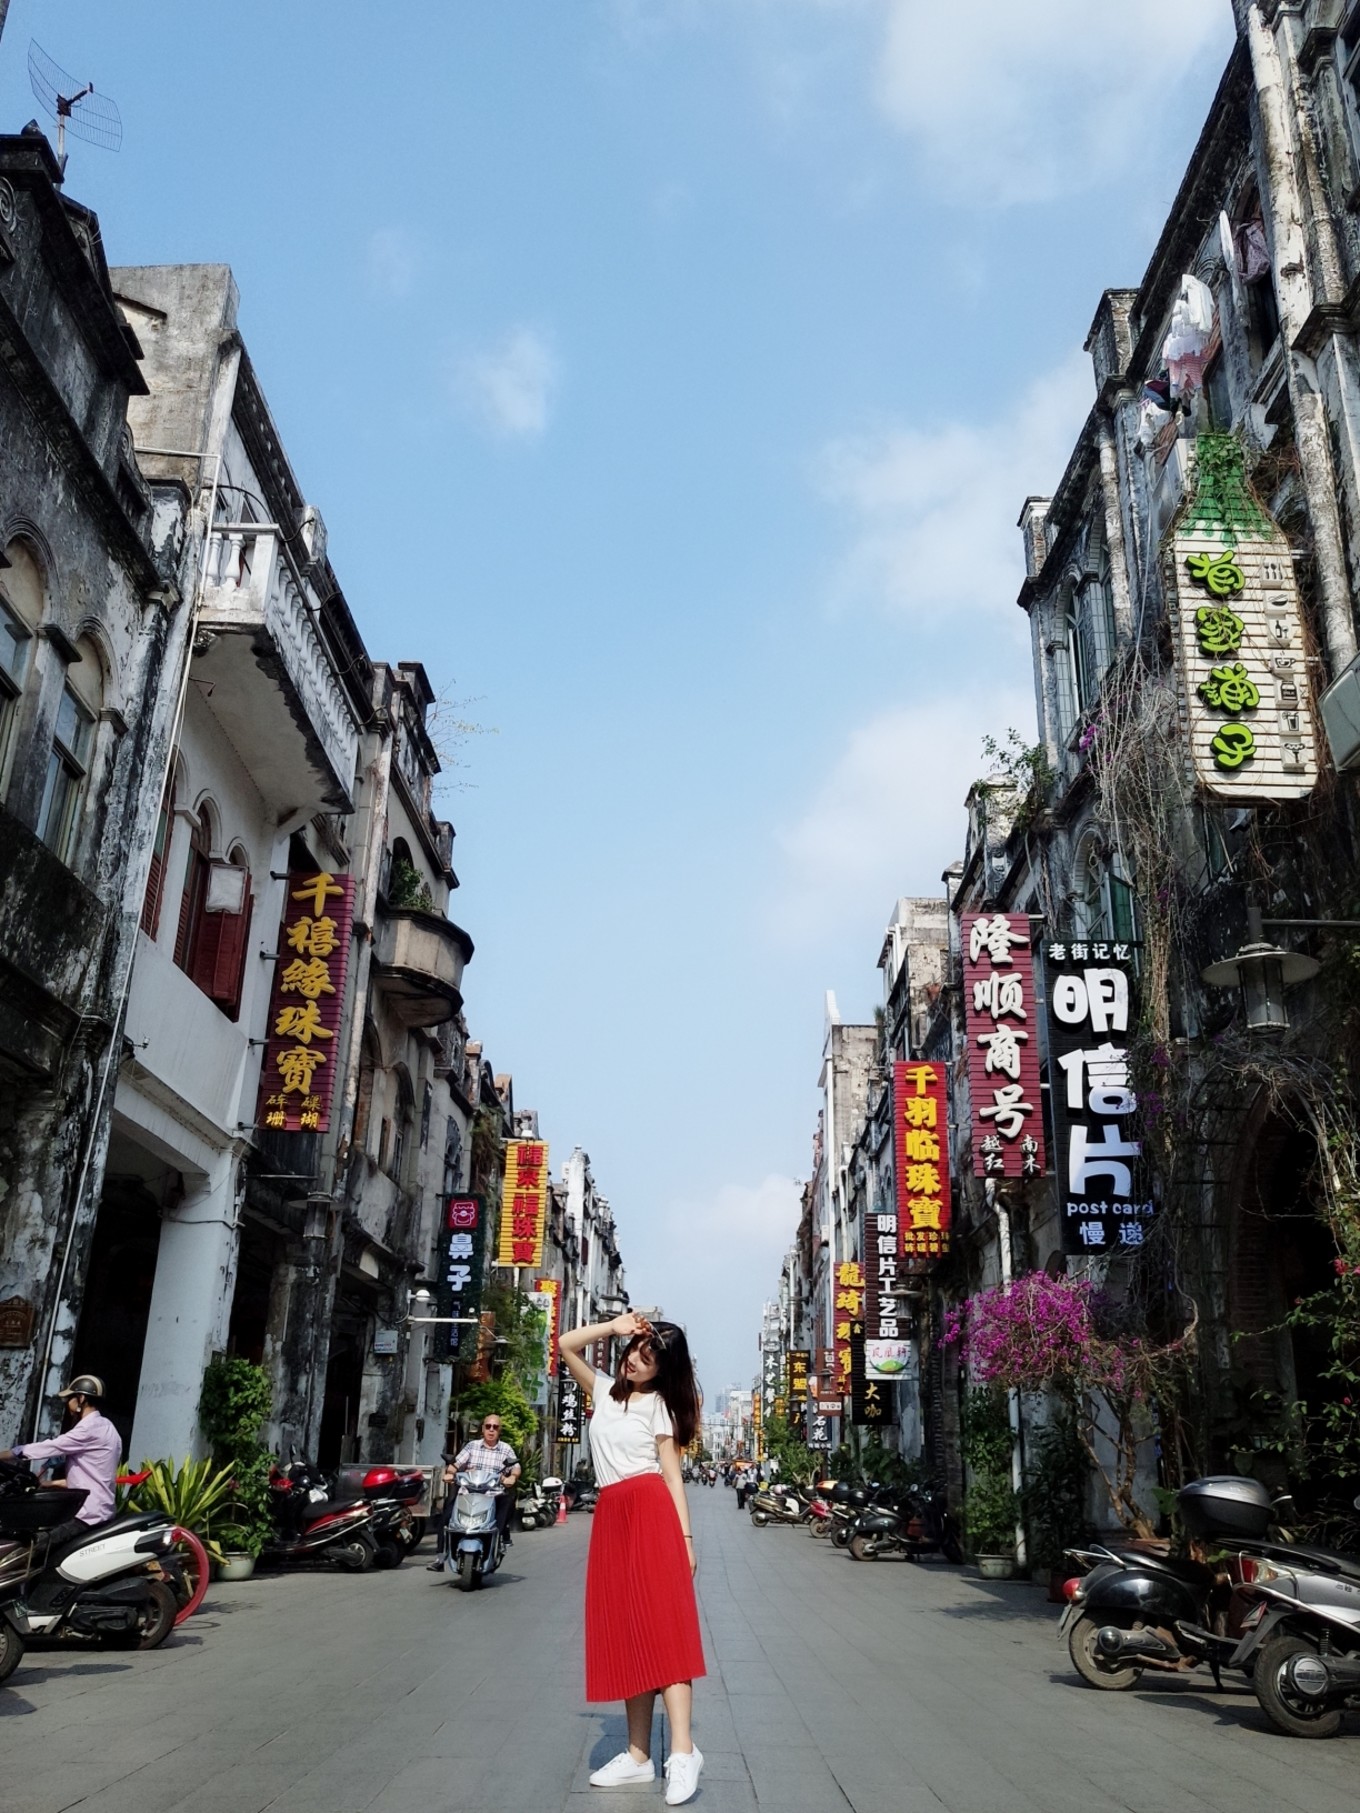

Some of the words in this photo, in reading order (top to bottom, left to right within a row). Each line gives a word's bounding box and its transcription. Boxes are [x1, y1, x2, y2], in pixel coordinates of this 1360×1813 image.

[1049, 943, 1131, 961] 老街记忆
[969, 914, 1034, 1138] 隆顺商号
[1052, 968, 1141, 1197] 明信片
[1067, 1201, 1108, 1217] post
[1112, 1200, 1154, 1216] card
[1079, 1221, 1143, 1245] 慢递
[447, 1233, 474, 1291] 鼻子
[877, 1214, 899, 1338] 明信片工艺品
